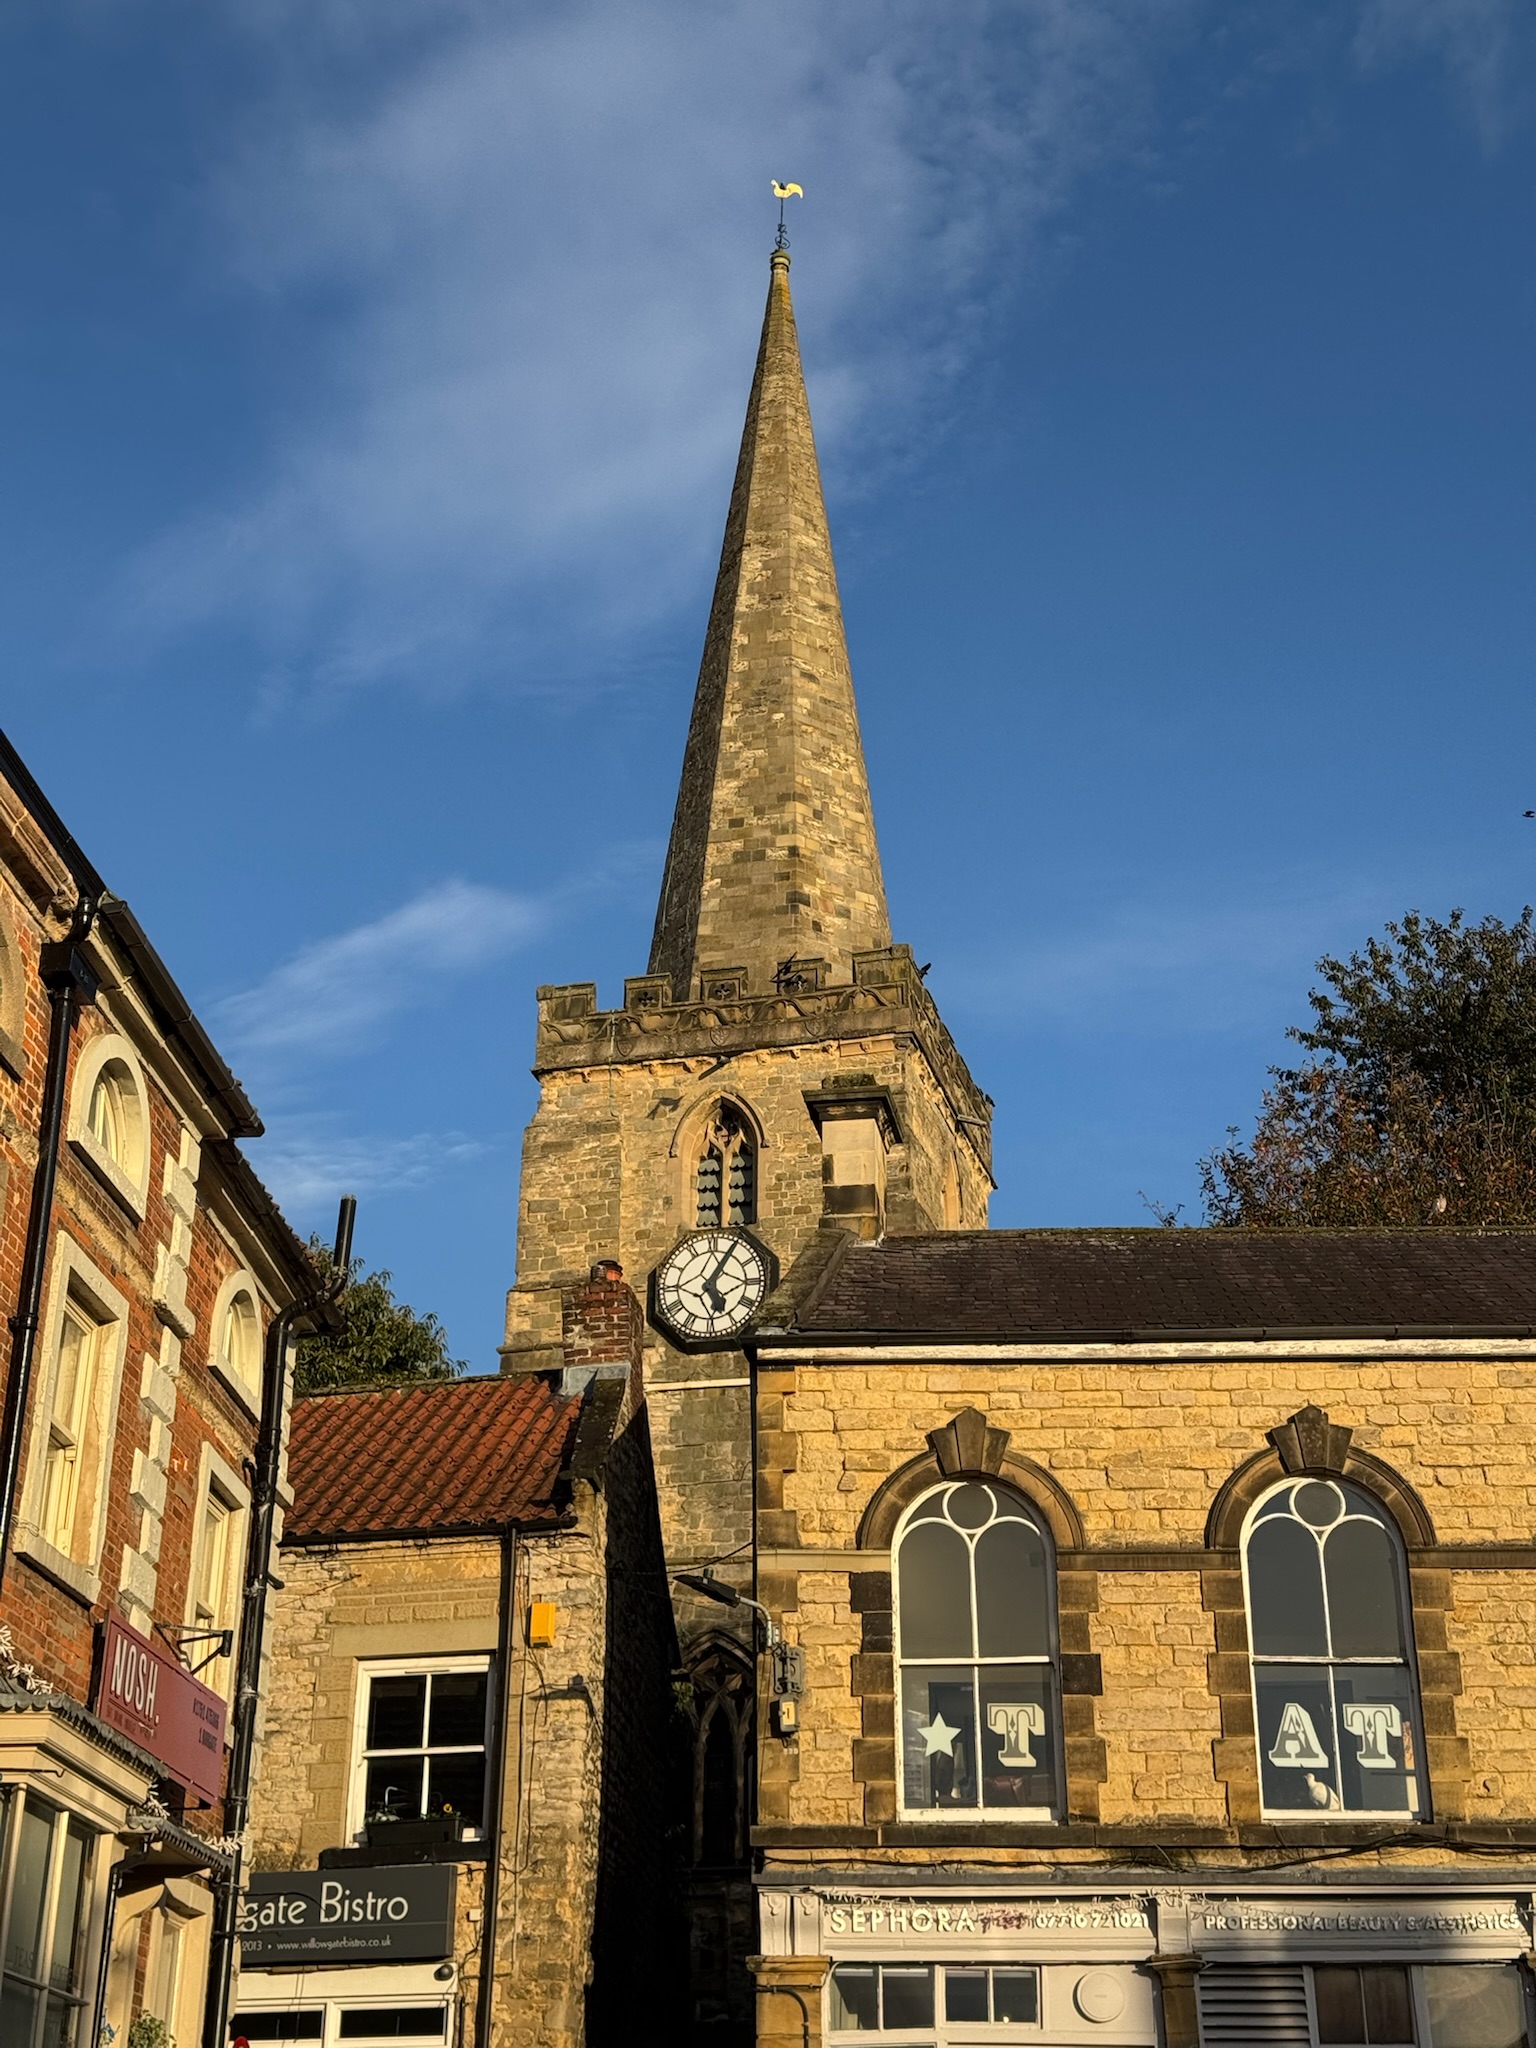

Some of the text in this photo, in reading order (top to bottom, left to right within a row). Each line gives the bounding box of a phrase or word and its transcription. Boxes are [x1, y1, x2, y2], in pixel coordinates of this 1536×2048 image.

[987, 1702, 1046, 1768] T
[243, 1881, 409, 1933] gate Bistro
[831, 1908, 976, 1933] SEPHORA
[1204, 1913, 1520, 1931] PROFESSIONAL BEAUTY & AESTHETICS
[242, 1935, 391, 1951] 2013 www.willowgatebistro.co.uk
